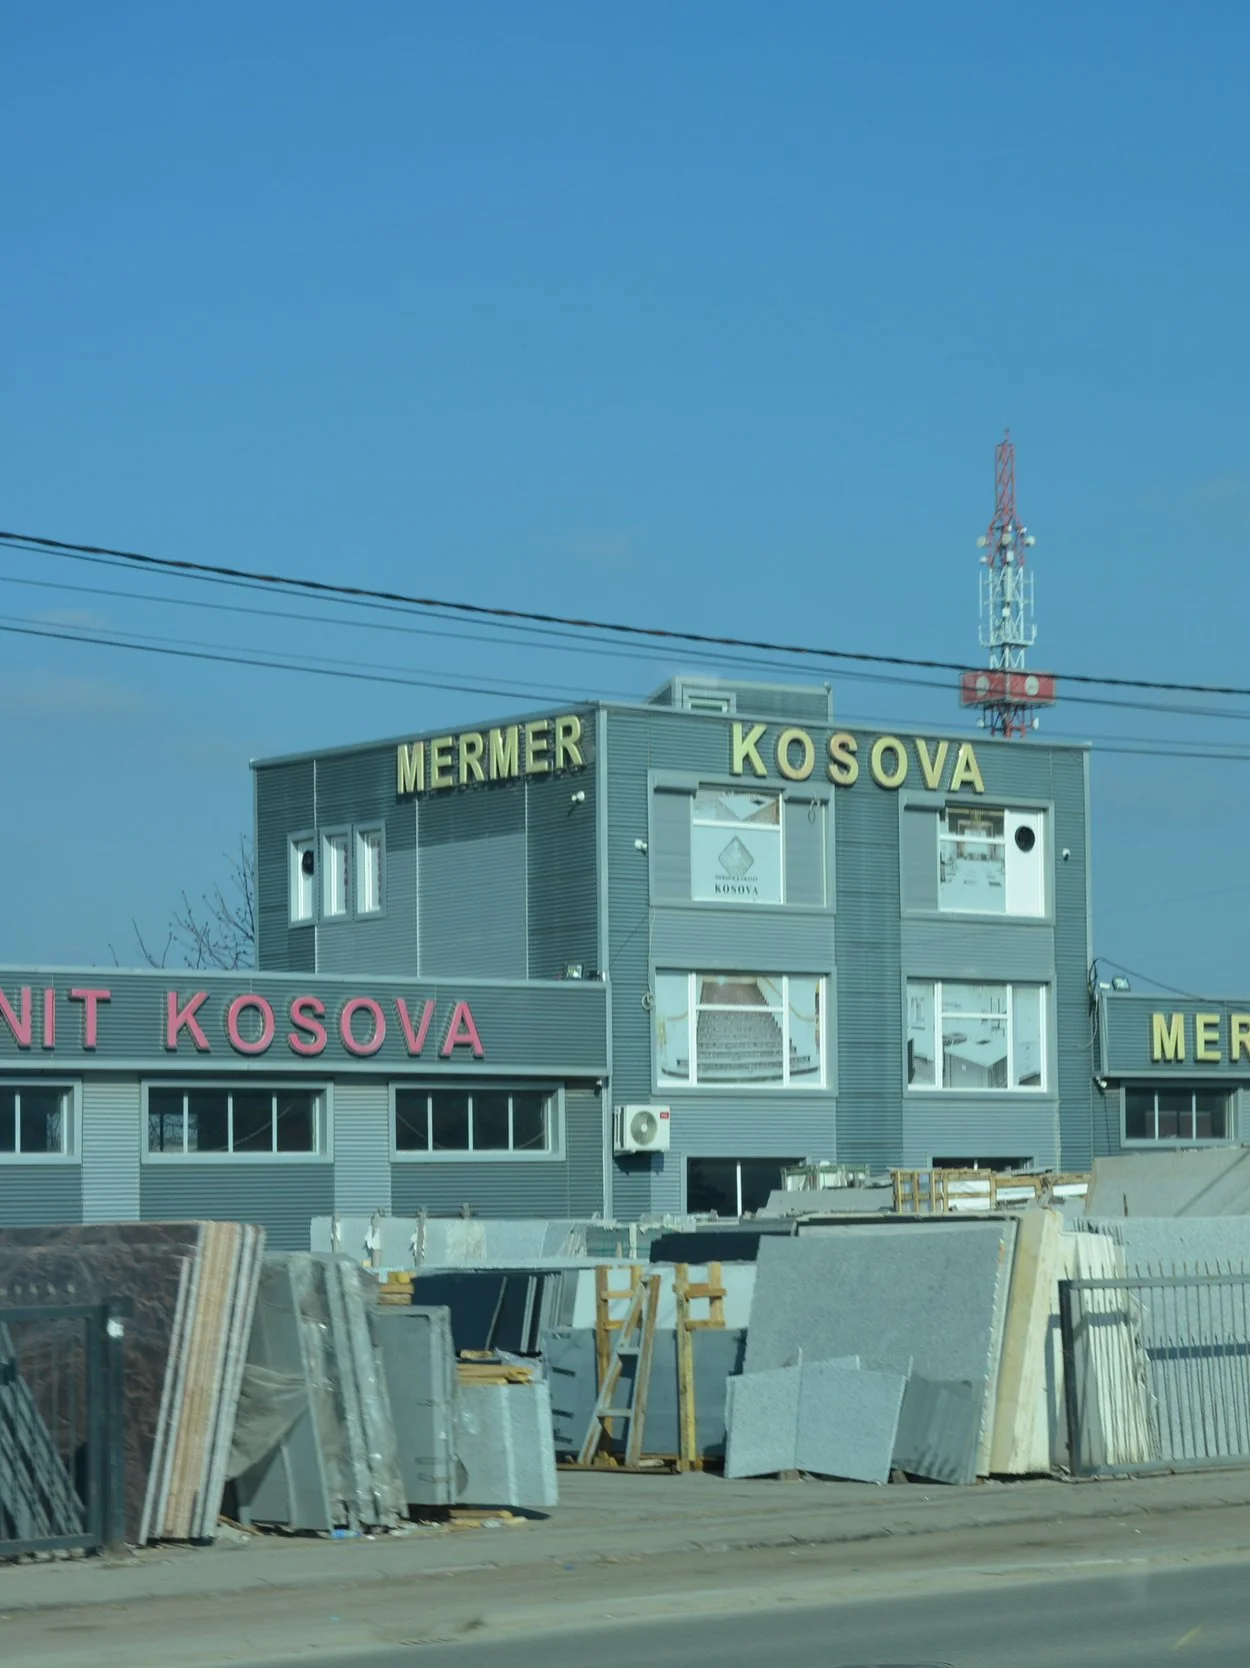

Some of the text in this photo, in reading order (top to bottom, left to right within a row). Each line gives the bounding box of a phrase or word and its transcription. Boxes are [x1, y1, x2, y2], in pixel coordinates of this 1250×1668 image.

[397, 714, 584, 795] MERMER
[730, 721, 985, 794] KOSOVA
[714, 883, 758, 895] KOSOVA
[166, 991, 485, 1057] KOSOVA
